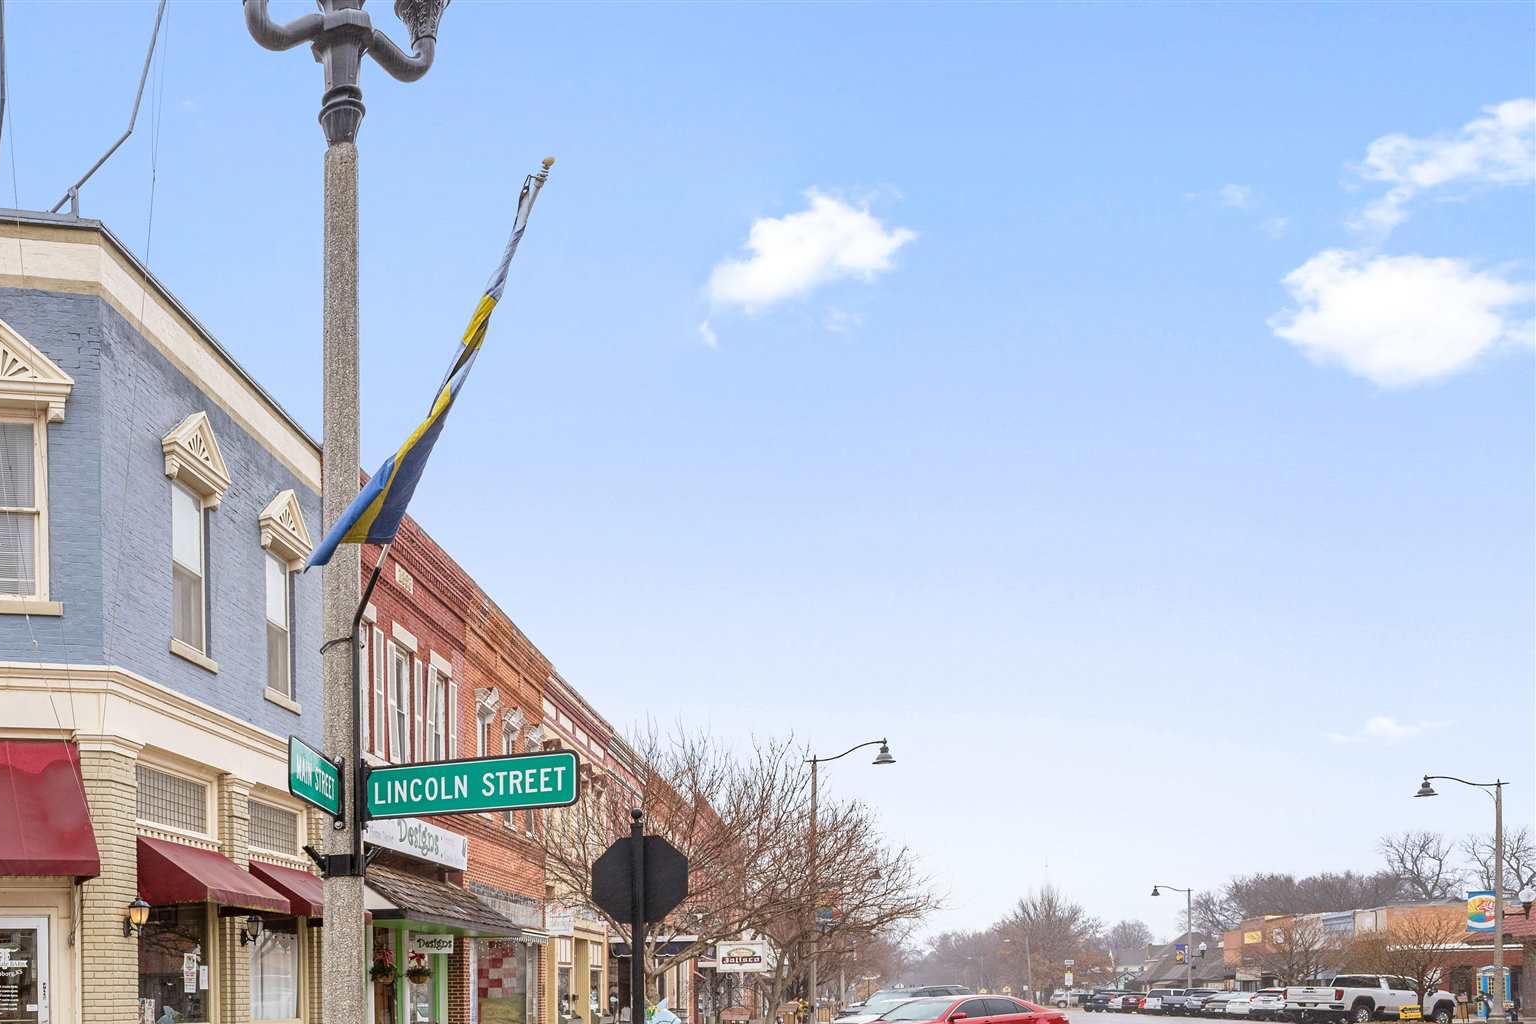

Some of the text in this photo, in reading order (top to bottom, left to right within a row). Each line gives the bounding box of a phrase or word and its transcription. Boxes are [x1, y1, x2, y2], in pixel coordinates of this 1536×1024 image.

[296, 751, 335, 801] MAIN STREET
[374, 766, 566, 805] LINCOLN STREET
[397, 820, 439, 857] Designs
[416, 938, 452, 951] Designs
